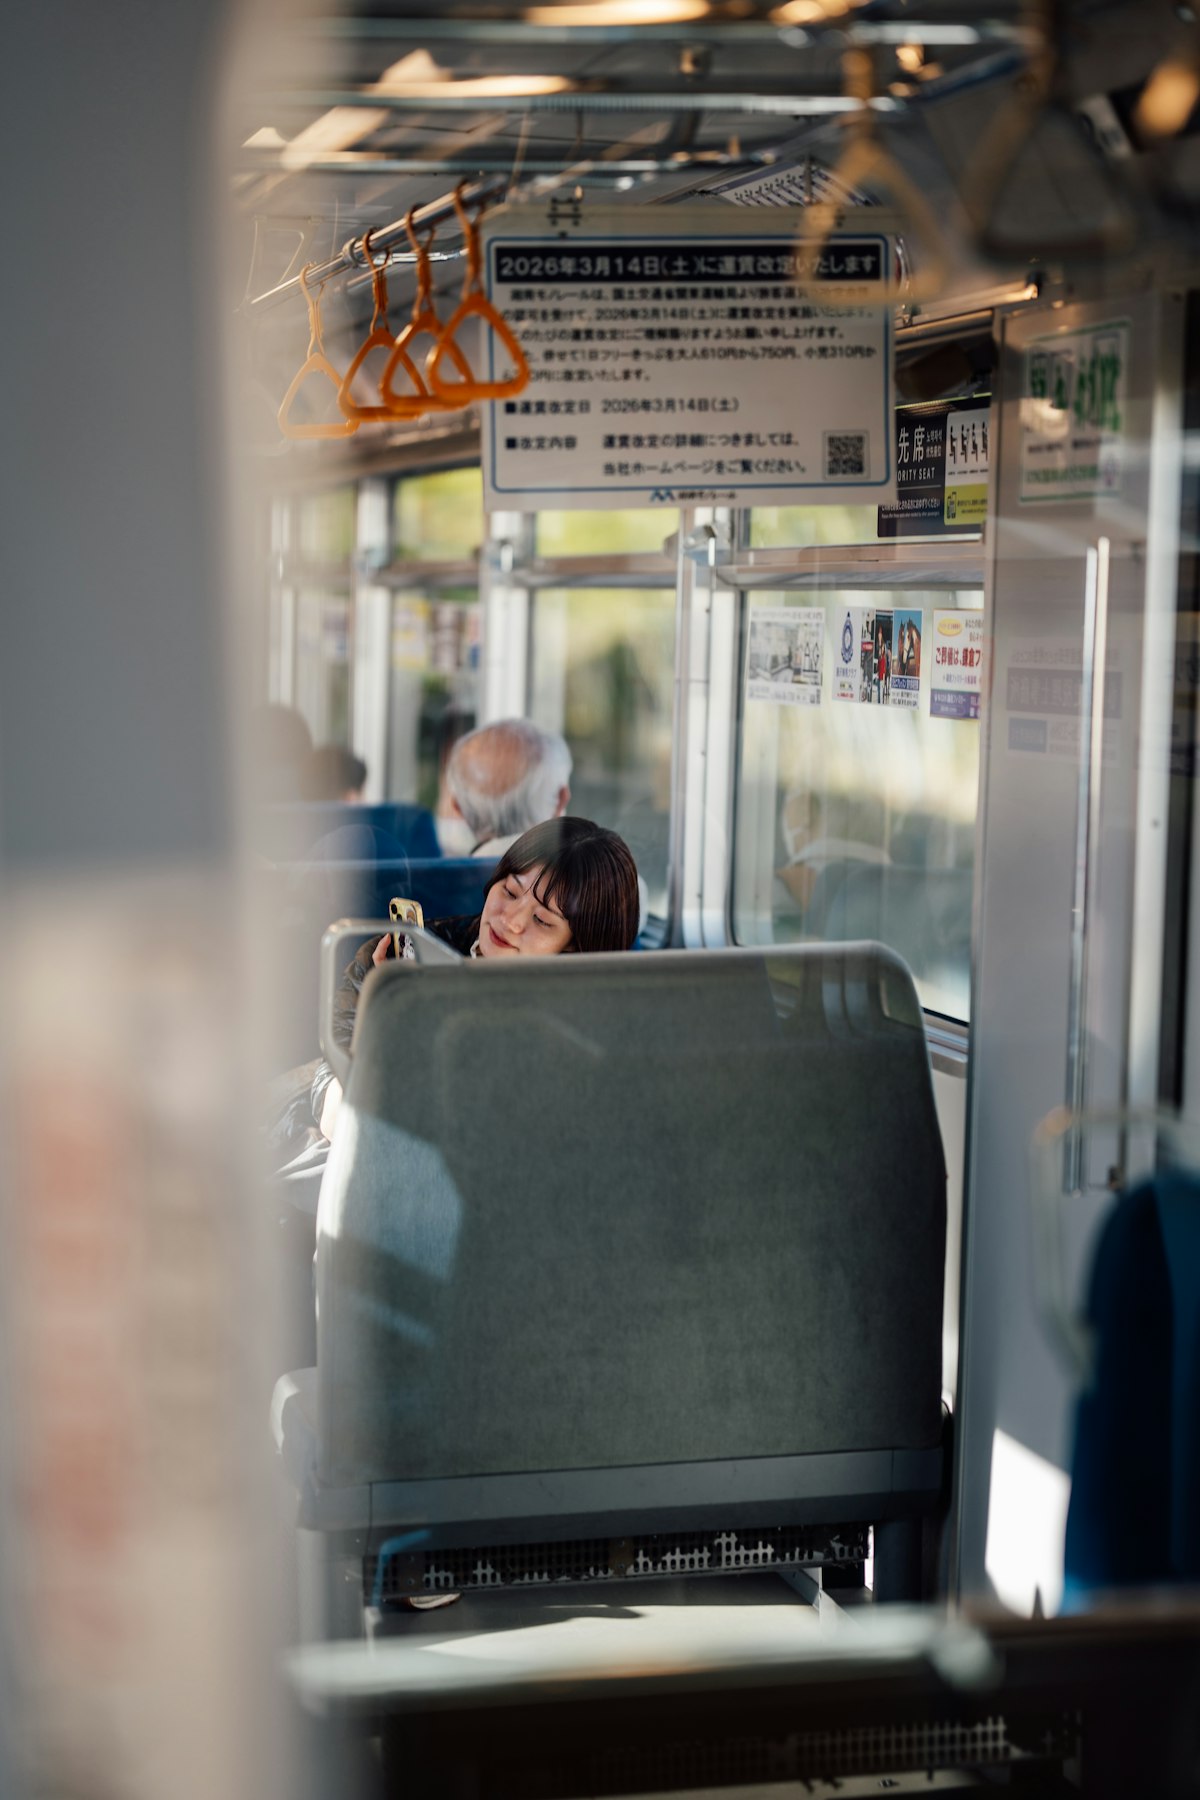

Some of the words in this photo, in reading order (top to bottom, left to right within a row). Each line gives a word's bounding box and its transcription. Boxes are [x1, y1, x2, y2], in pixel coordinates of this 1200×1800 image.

[500, 255, 877, 277] 2026年3月14日(土)に運賃改定いたします
[522, 345, 877, 363] た、併せて1日フリーきっぷを大人610円から750円、小児310円か
[502, 369, 652, 384] ら0円に改定いたします。
[601, 396, 741, 414] 2026年3月14日(土)
[520, 434, 578, 451] 改定内容
[897, 468, 917, 482] ORITY
[918, 466, 936, 480] SEAT
